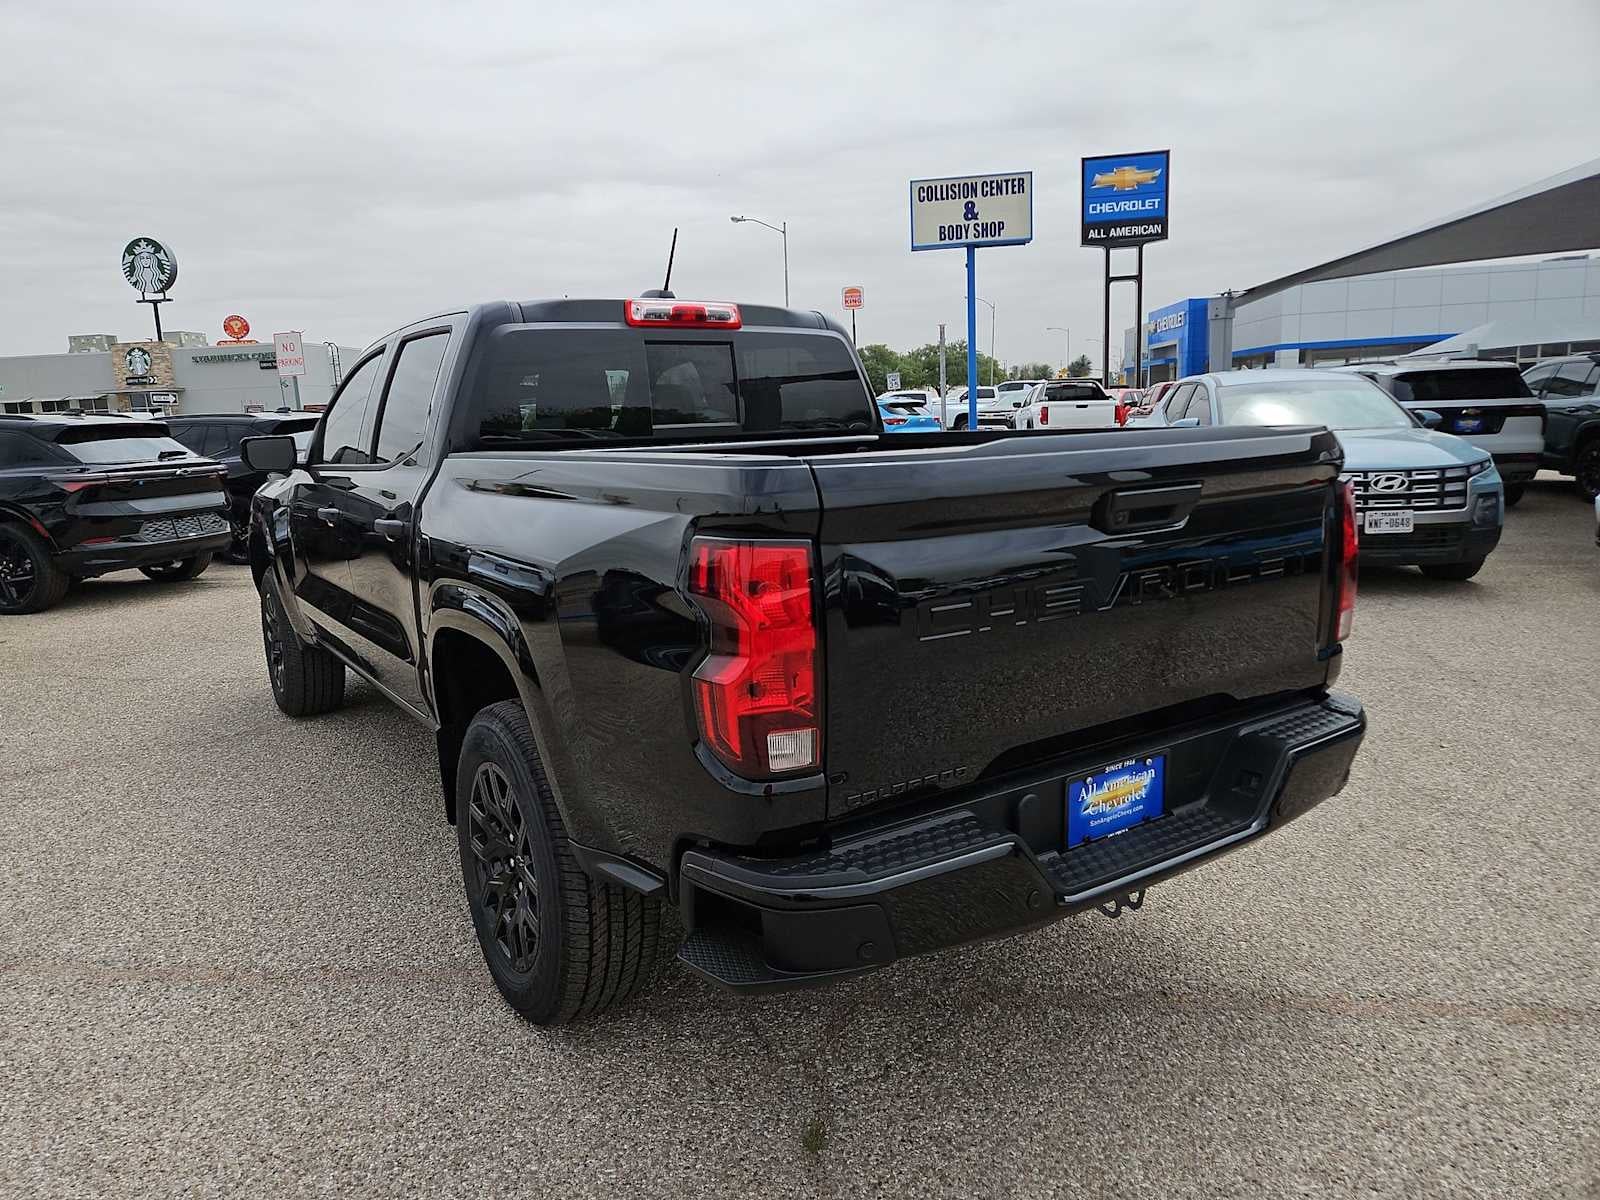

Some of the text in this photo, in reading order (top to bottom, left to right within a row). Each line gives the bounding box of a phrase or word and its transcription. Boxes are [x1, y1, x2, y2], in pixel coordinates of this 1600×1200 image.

[917, 177, 1025, 203] COLLISION CENTER
[963, 200, 979, 221] &
[1088, 198, 1161, 214] CHEVROLET
[938, 221, 1005, 241] BODY SHOP
[1088, 224, 1162, 239] ALL AMERICAN
[282, 342, 296, 352] NO
[278, 357, 303, 369] PARKING
[916, 543, 1314, 641] CHEVROLET
[1078, 768, 1156, 802] All American
[1088, 786, 1147, 816] Chevrolet
